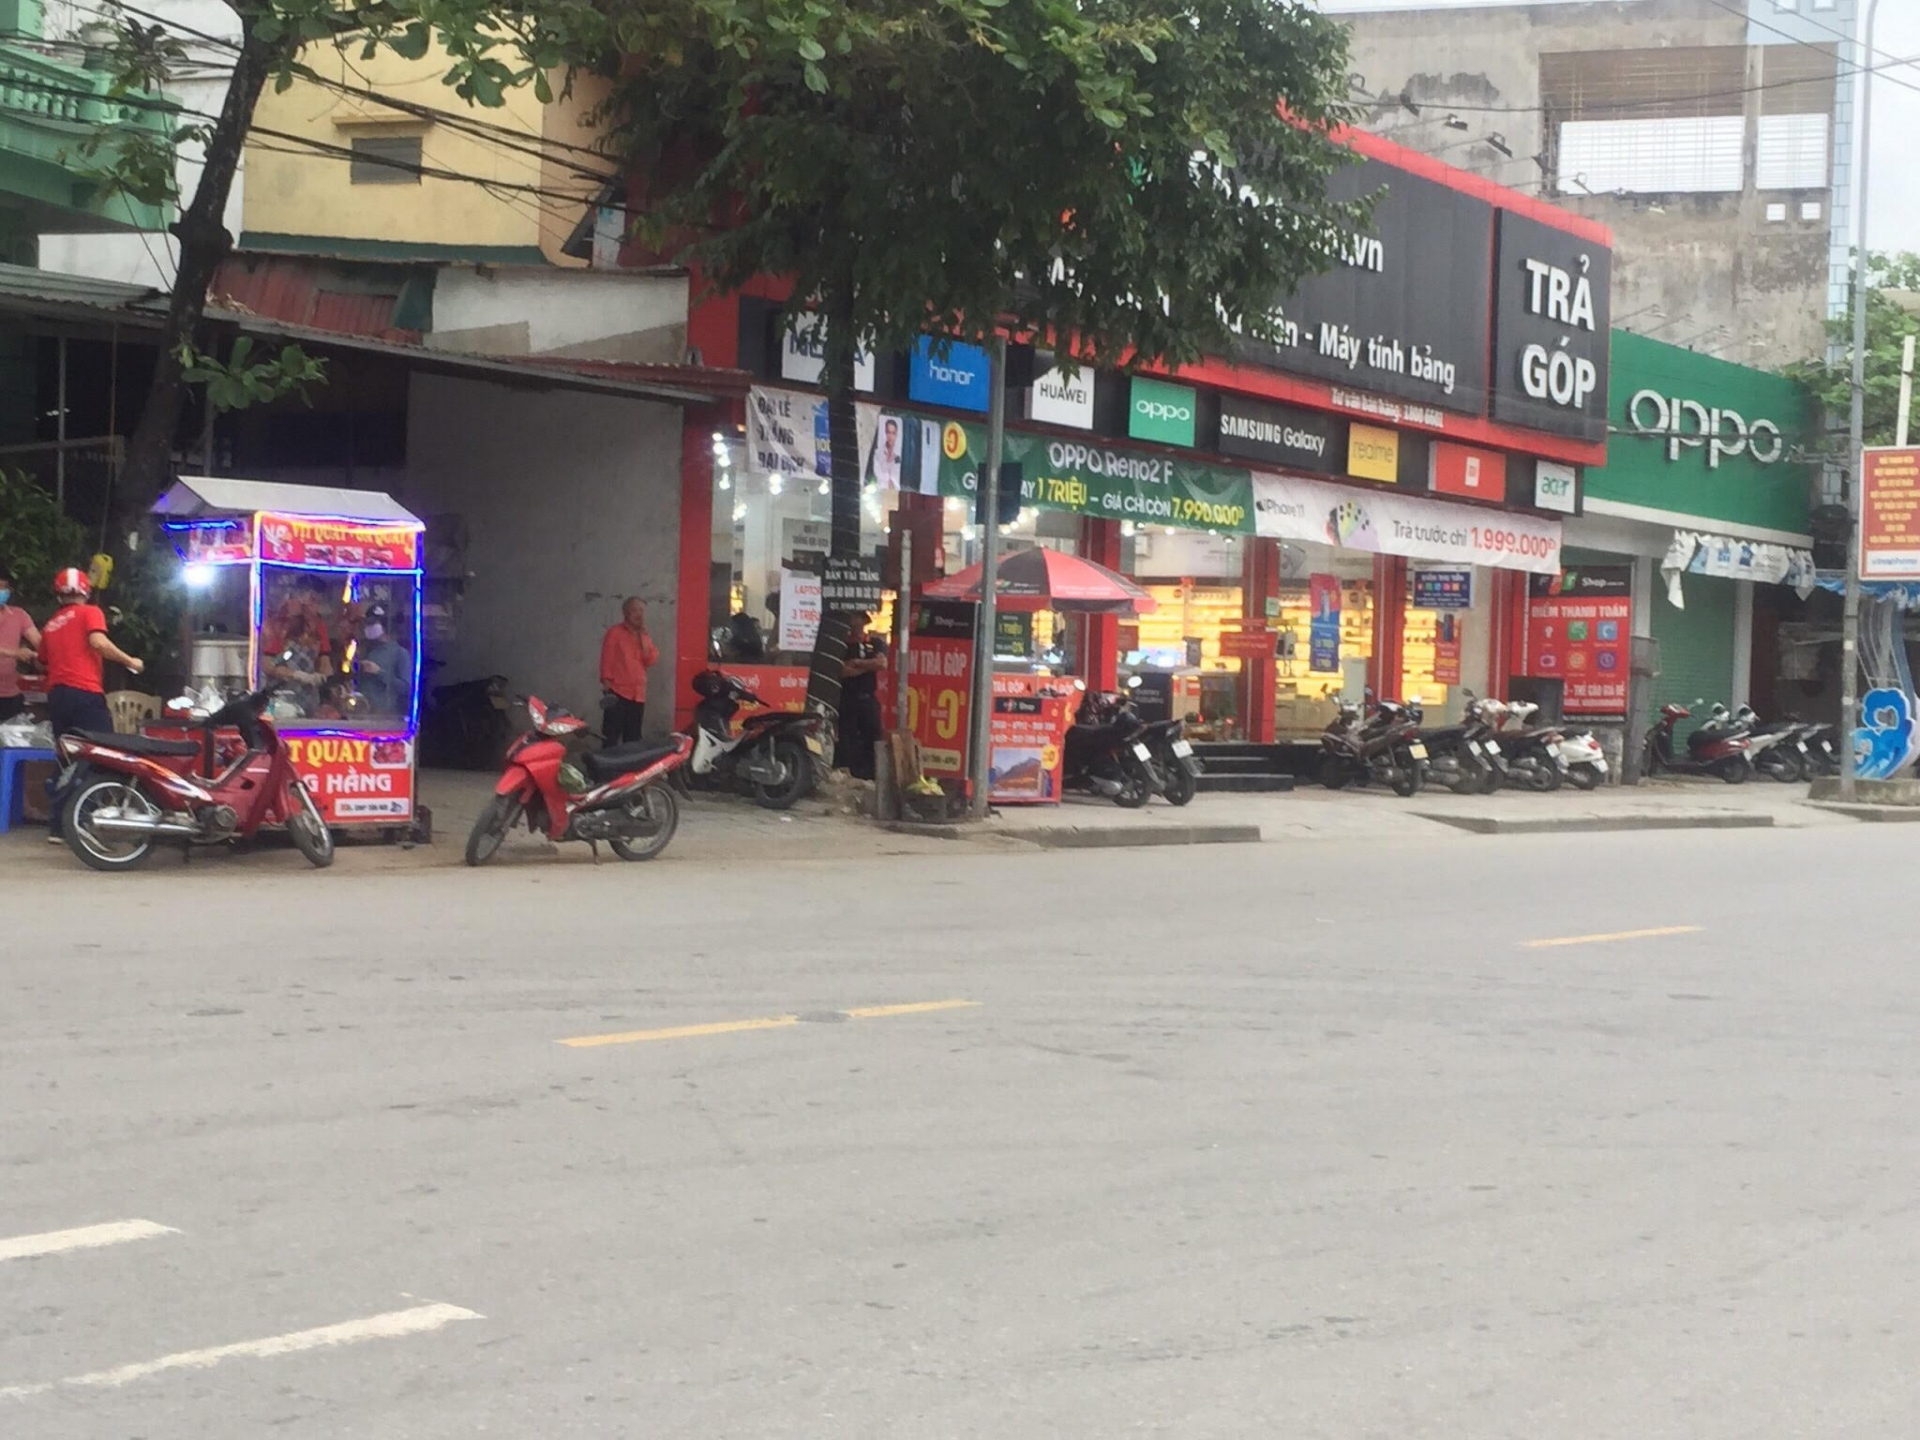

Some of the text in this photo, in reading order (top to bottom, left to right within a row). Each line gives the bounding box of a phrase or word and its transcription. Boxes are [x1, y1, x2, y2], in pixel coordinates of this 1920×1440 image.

[1526, 254, 1595, 331] TRẢ
[929, 361, 975, 385] honor
[1320, 322, 1361, 369] Máy
[1368, 335, 1405, 373] tính
[1411, 345, 1455, 394] bảng
[1522, 336, 1596, 408] GÓP
[1040, 383, 1087, 405] HUAWEI
[1221, 414, 1326, 457] SAMSUNG Galaxy
[1352, 438, 1394, 463] realme
[1049, 442, 1173, 484] OPPO Reno2 F
[1020, 481, 1036, 498] AY
[1047, 476, 1087, 511] TRIỆU
[1102, 491, 1122, 510] GIÁ
[1145, 496, 1171, 517] CÒN
[1541, 475, 1570, 496] acer
[1393, 520, 1413, 539] Trả
[1415, 526, 1447, 544] trước
[1450, 529, 1468, 547] chỉ
[921, 644, 941, 675] TRẢ
[944, 648, 967, 677] GÓP
[307, 740, 369, 768] QUAY
